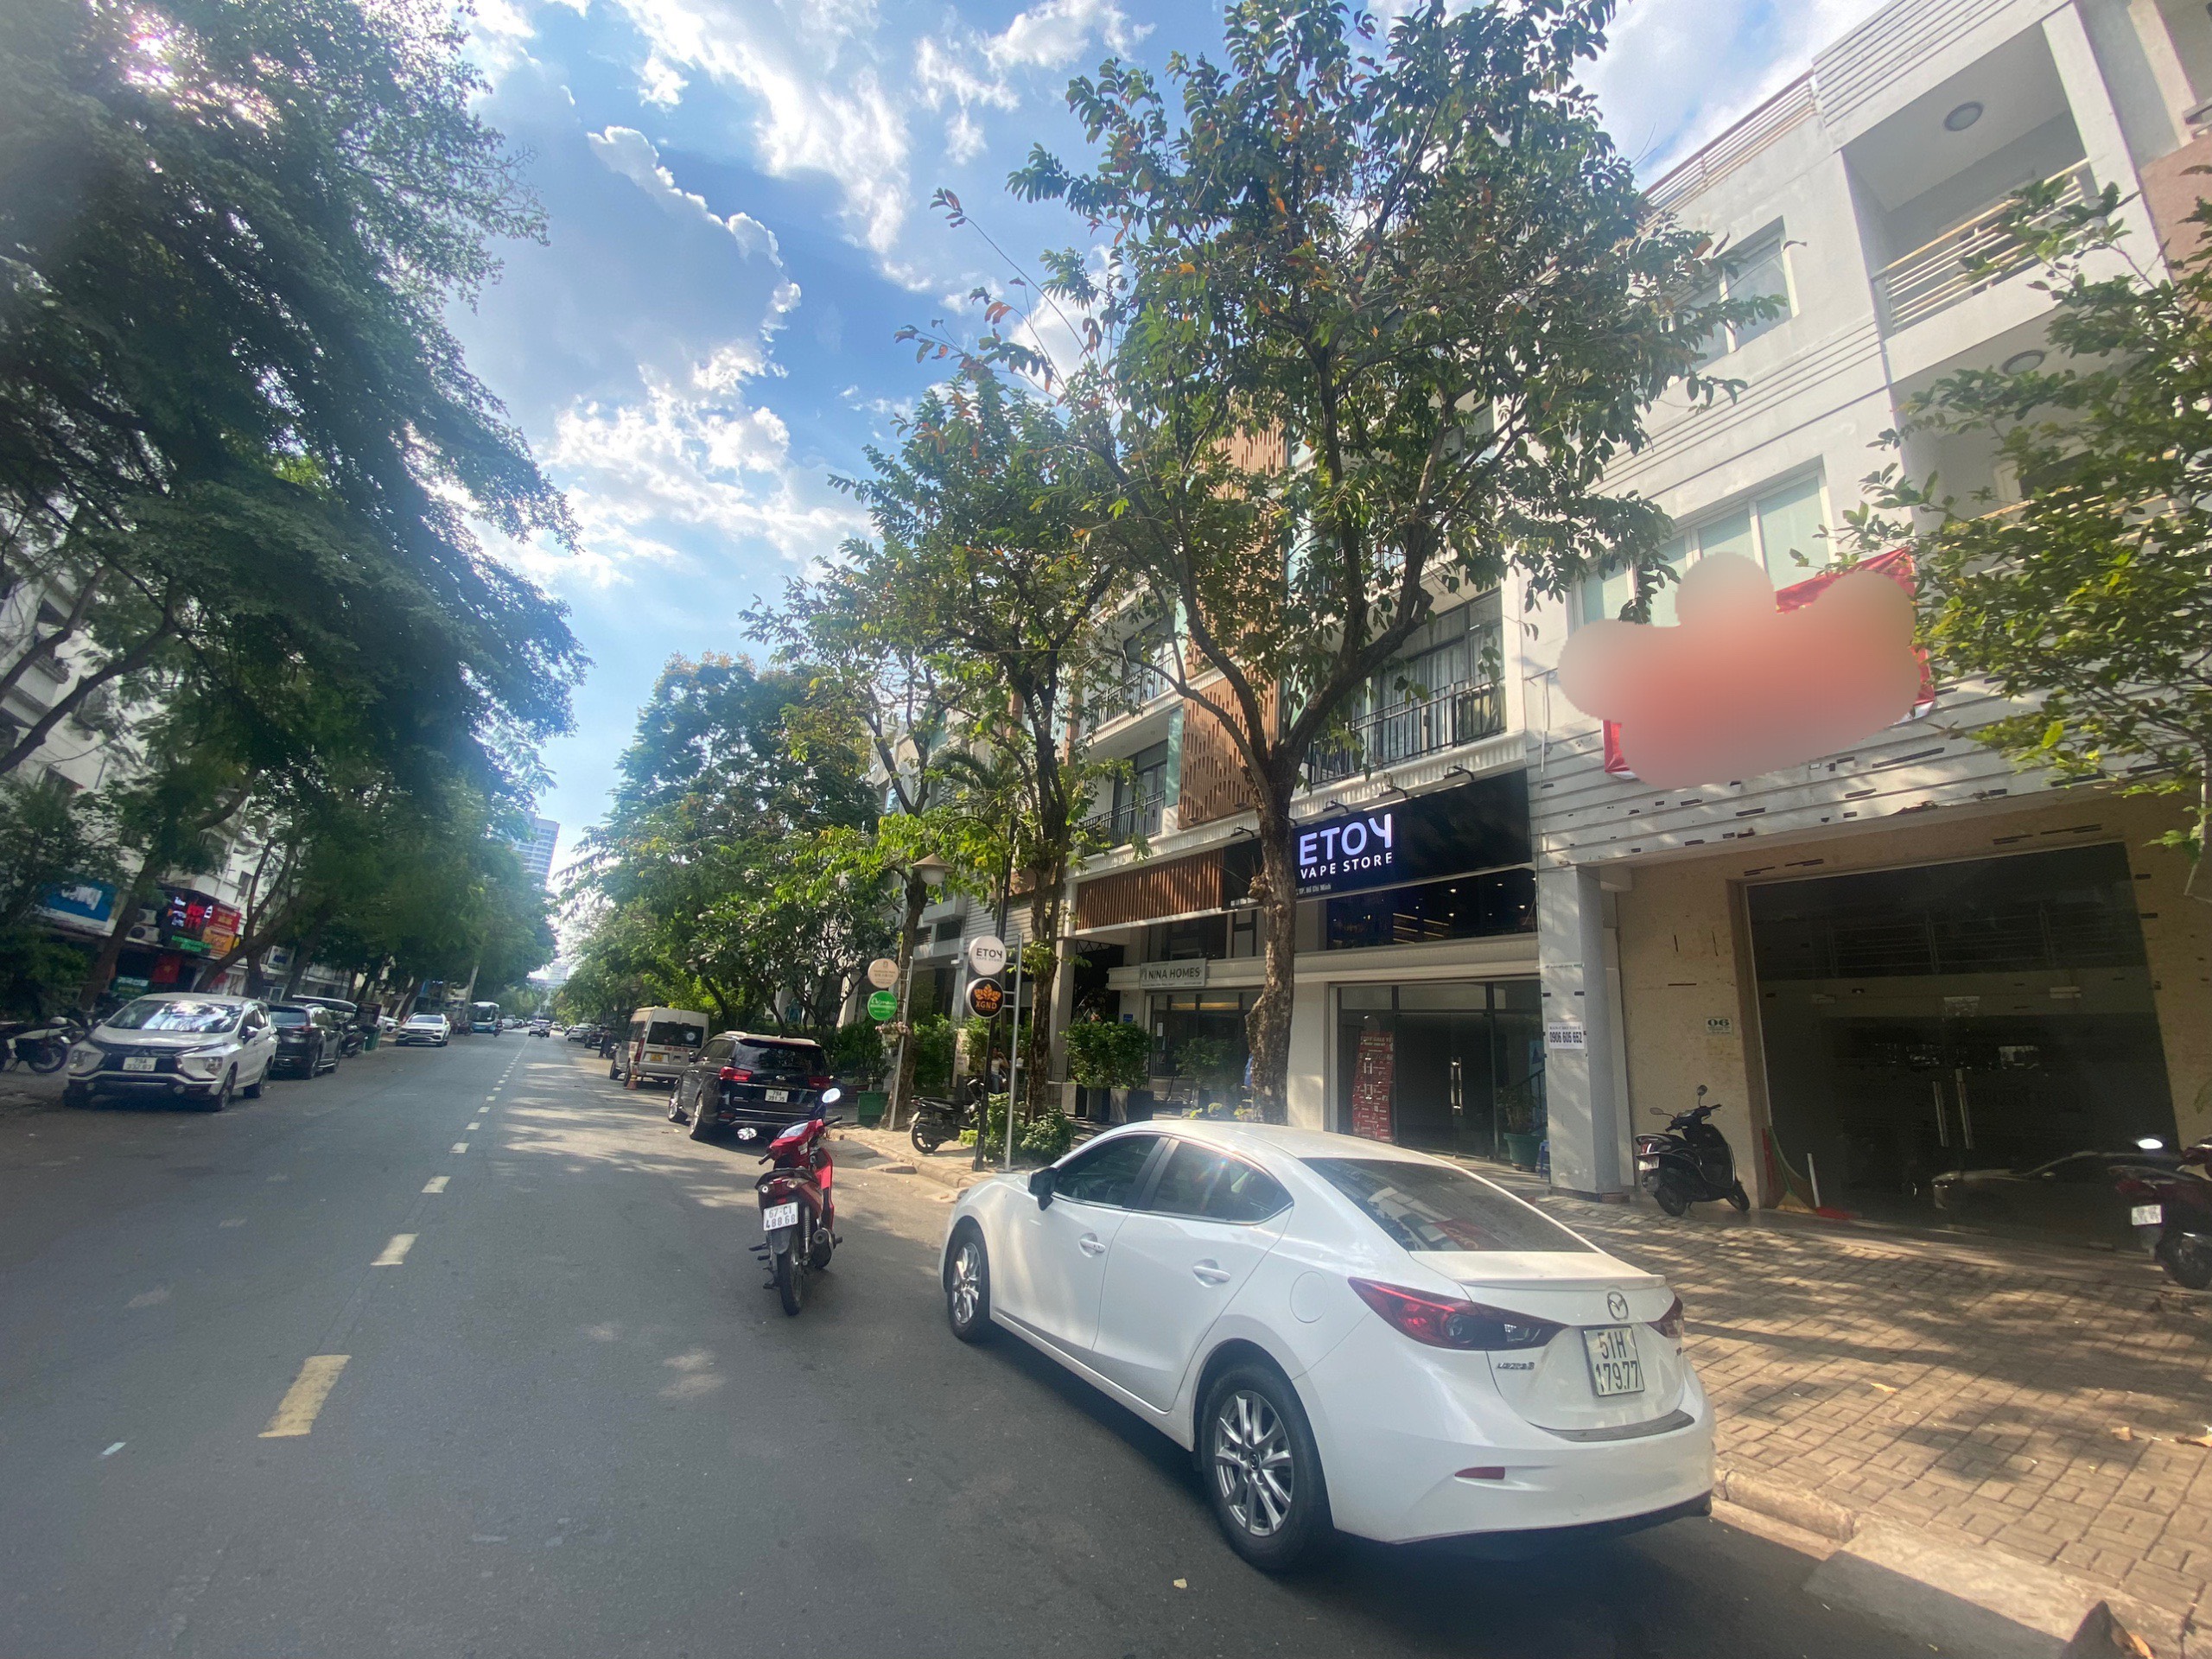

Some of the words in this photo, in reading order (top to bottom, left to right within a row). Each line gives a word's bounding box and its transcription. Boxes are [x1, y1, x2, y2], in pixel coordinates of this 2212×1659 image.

[1300, 813, 1392, 866] ETOY
[1300, 863, 1336, 880] VAPE
[1343, 852, 1393, 873] STORE
[976, 947, 1002, 959] ETOY
[1148, 969, 1168, 980] NINA
[1169, 966, 1201, 979] HOMES
[976, 1000, 998, 1010] XGND
[1707, 1018, 1730, 1027] 06
[769, 1205, 791, 1218] 67-C1
[1597, 1331, 1627, 1360] 51H
[1595, 1360, 1639, 1393] 179.77
